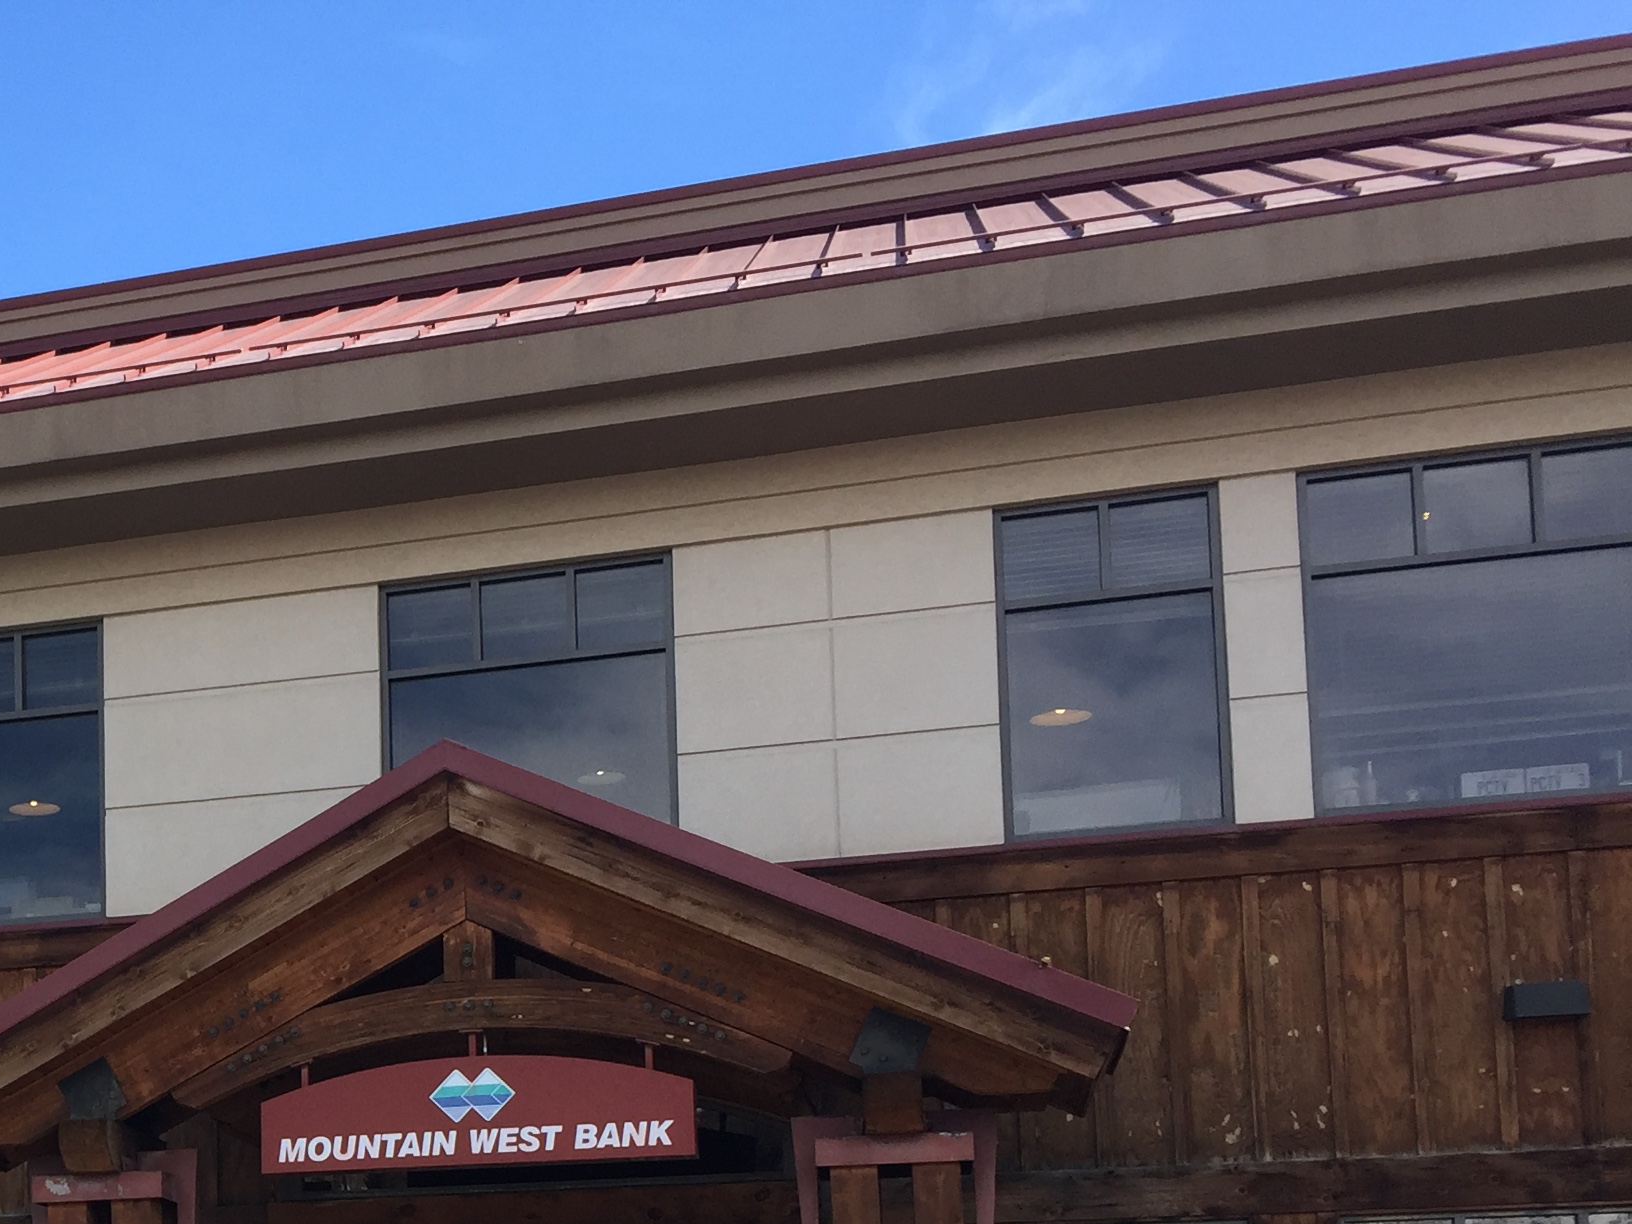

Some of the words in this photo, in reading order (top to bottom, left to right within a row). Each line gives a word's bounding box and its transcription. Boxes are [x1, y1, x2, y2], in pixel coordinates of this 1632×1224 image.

[278, 1130, 456, 1163] MOUNTAIN
[469, 1125, 563, 1154] WEST
[574, 1120, 674, 1150] BANK
